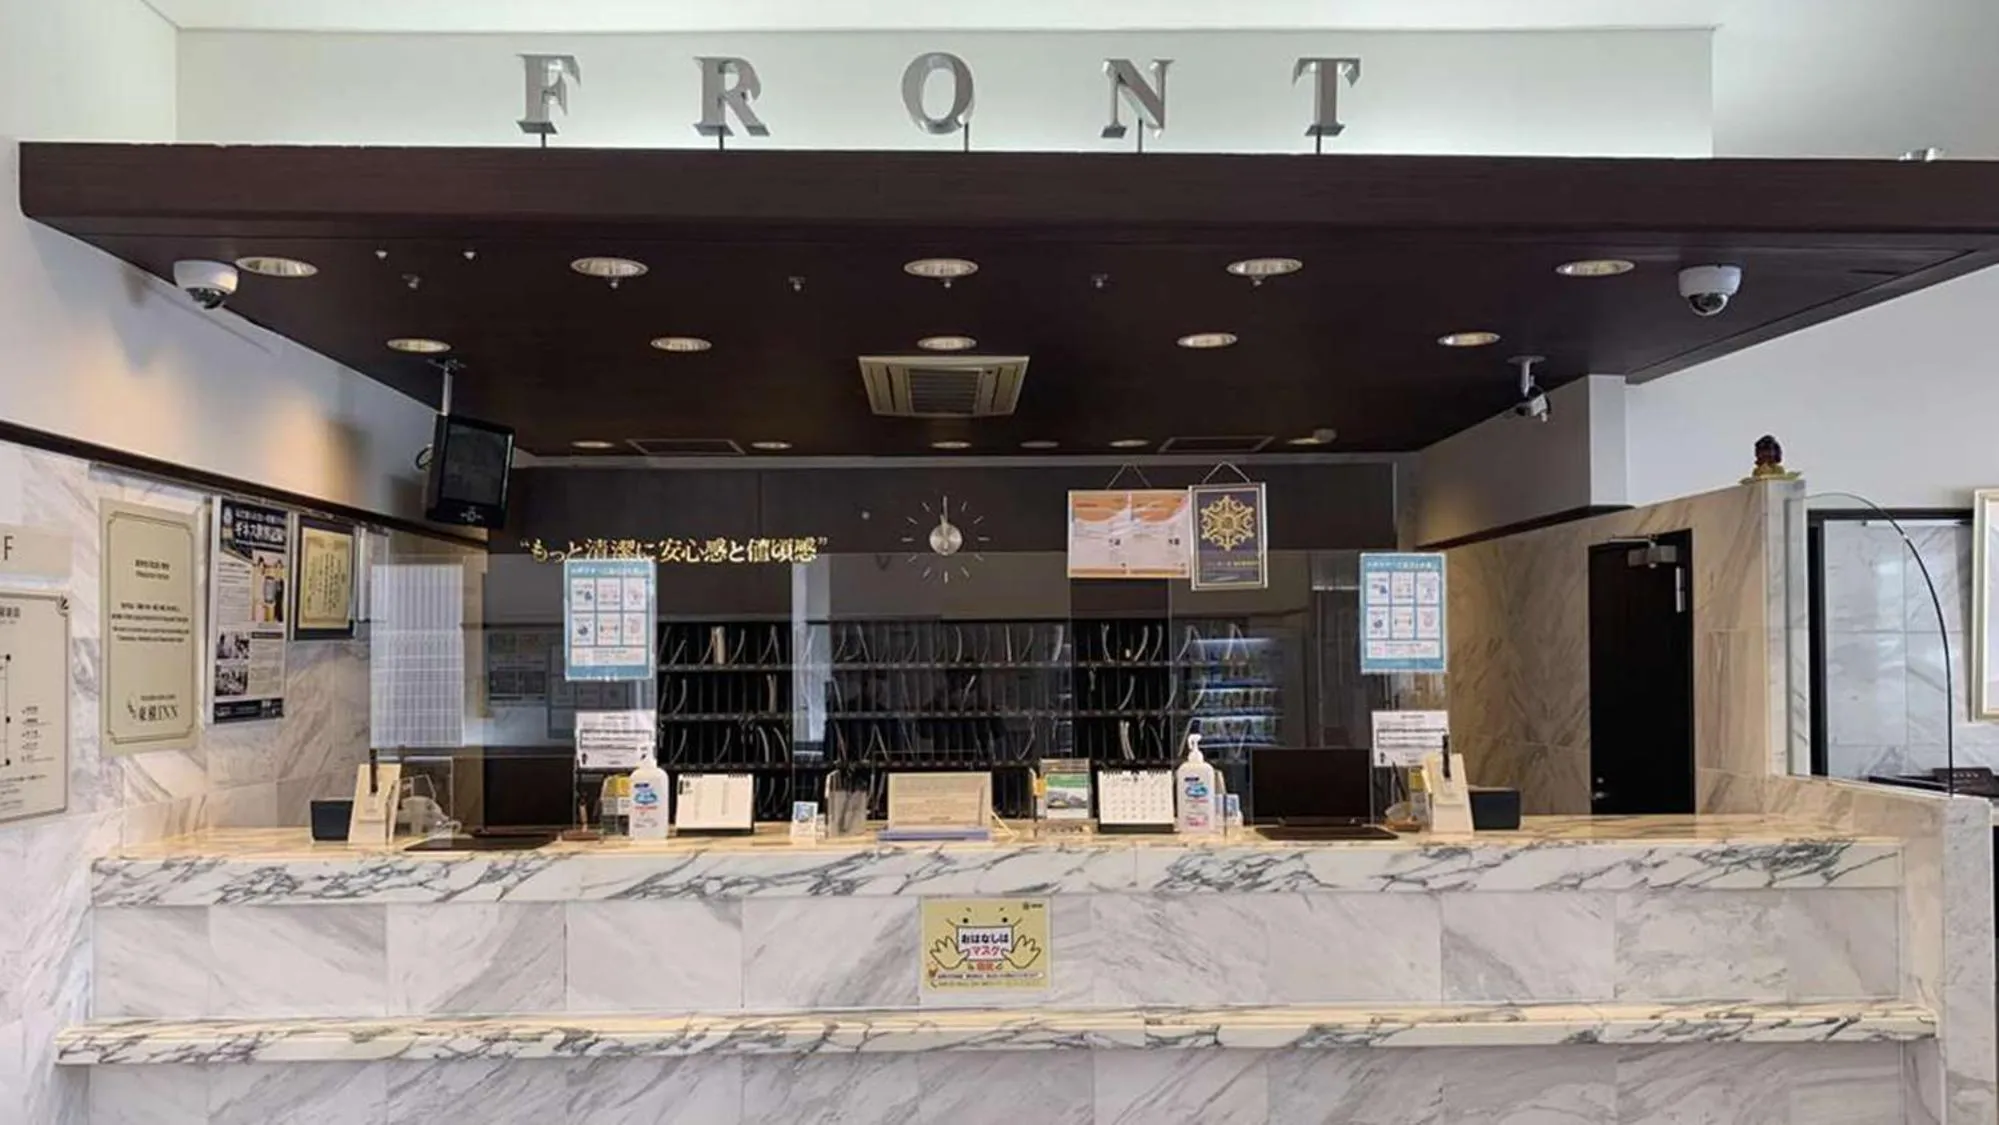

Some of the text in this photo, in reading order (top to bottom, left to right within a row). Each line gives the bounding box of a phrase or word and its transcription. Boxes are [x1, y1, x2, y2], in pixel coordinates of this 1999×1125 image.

[515, 51, 1361, 138] FRONT
[961, 933, 1009, 944] おはなしは
[972, 945, 1000, 956] マスク
